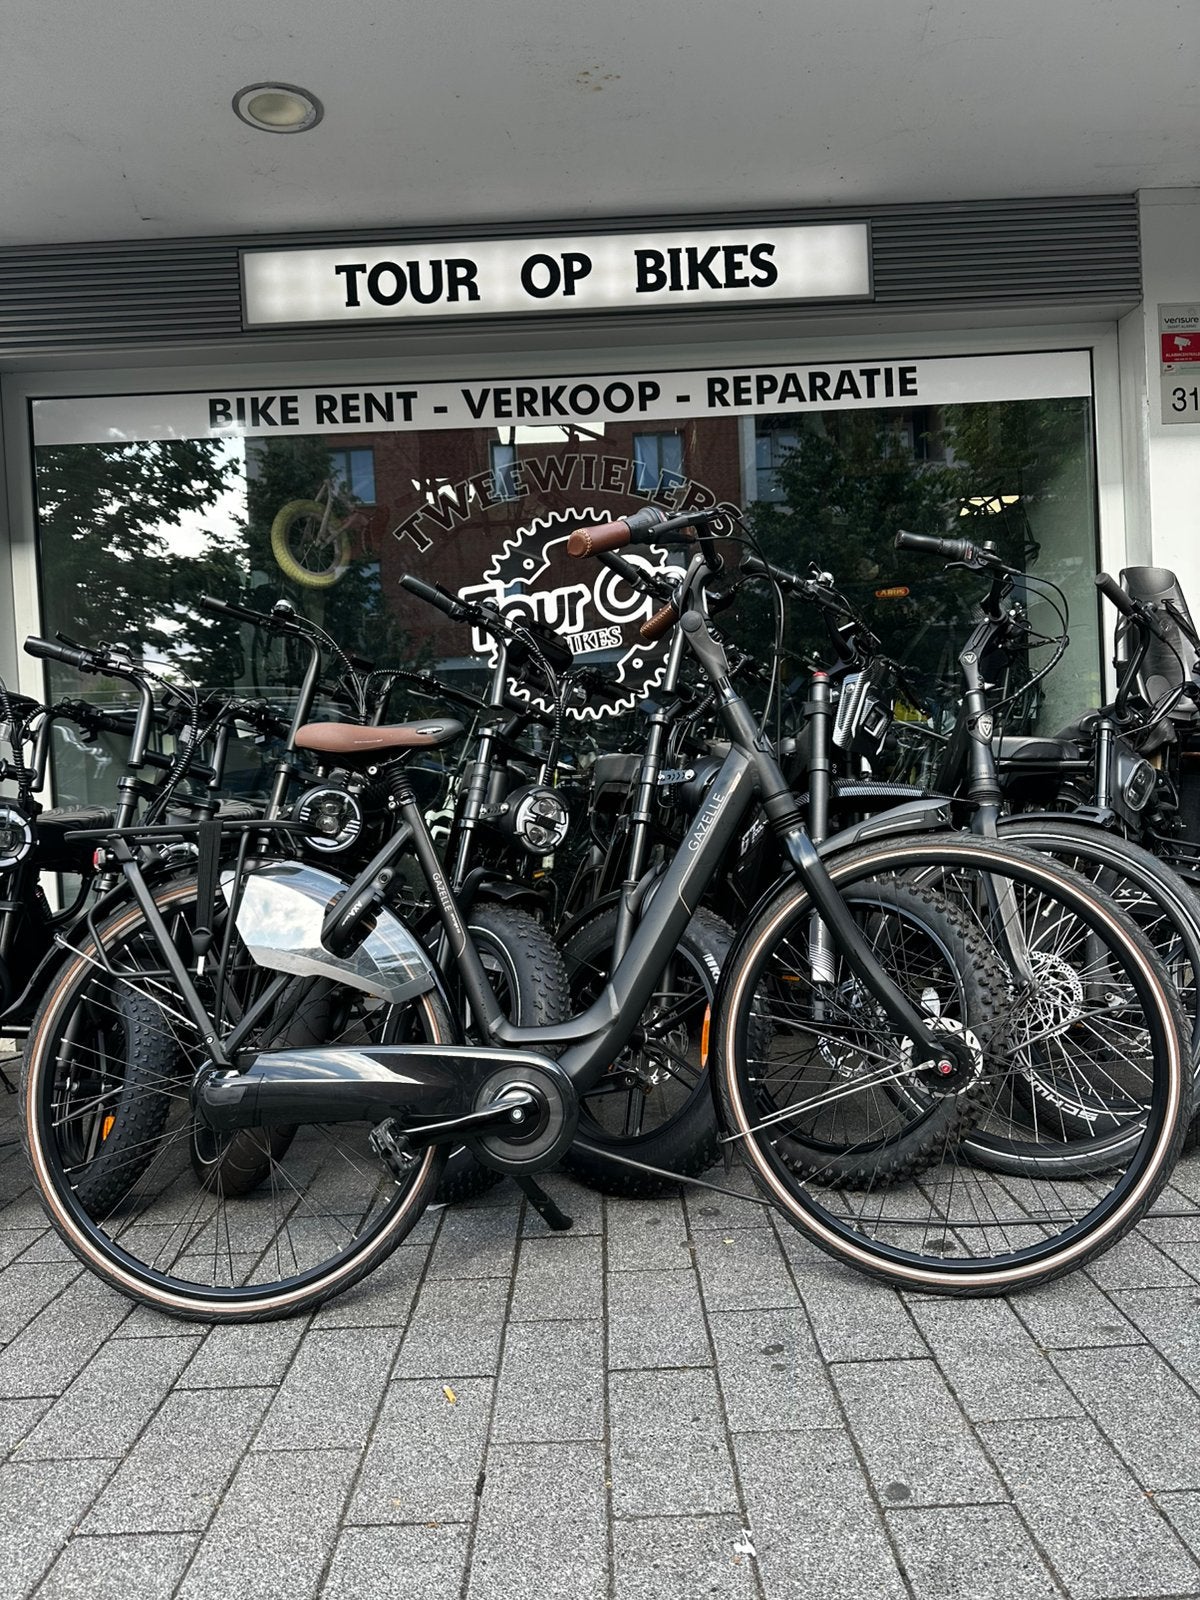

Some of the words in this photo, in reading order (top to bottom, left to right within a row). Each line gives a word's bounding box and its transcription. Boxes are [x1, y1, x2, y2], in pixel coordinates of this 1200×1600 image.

[335, 259, 480, 307] TOUR
[520, 252, 592, 298] OP
[634, 243, 778, 293] BIKES
[208, 395, 299, 429] BIKE
[315, 391, 418, 425] RENT
[461, 381, 661, 419] VERKOOP
[707, 366, 918, 408] REPARATIE
[1172, 387, 1198, 412] 31
[393, 453, 744, 553] TWEEWIELERS
[564, 625, 622, 655] IKES
[688, 792, 725, 851] GAZELLE
[432, 872, 452, 912] GAZELLE
